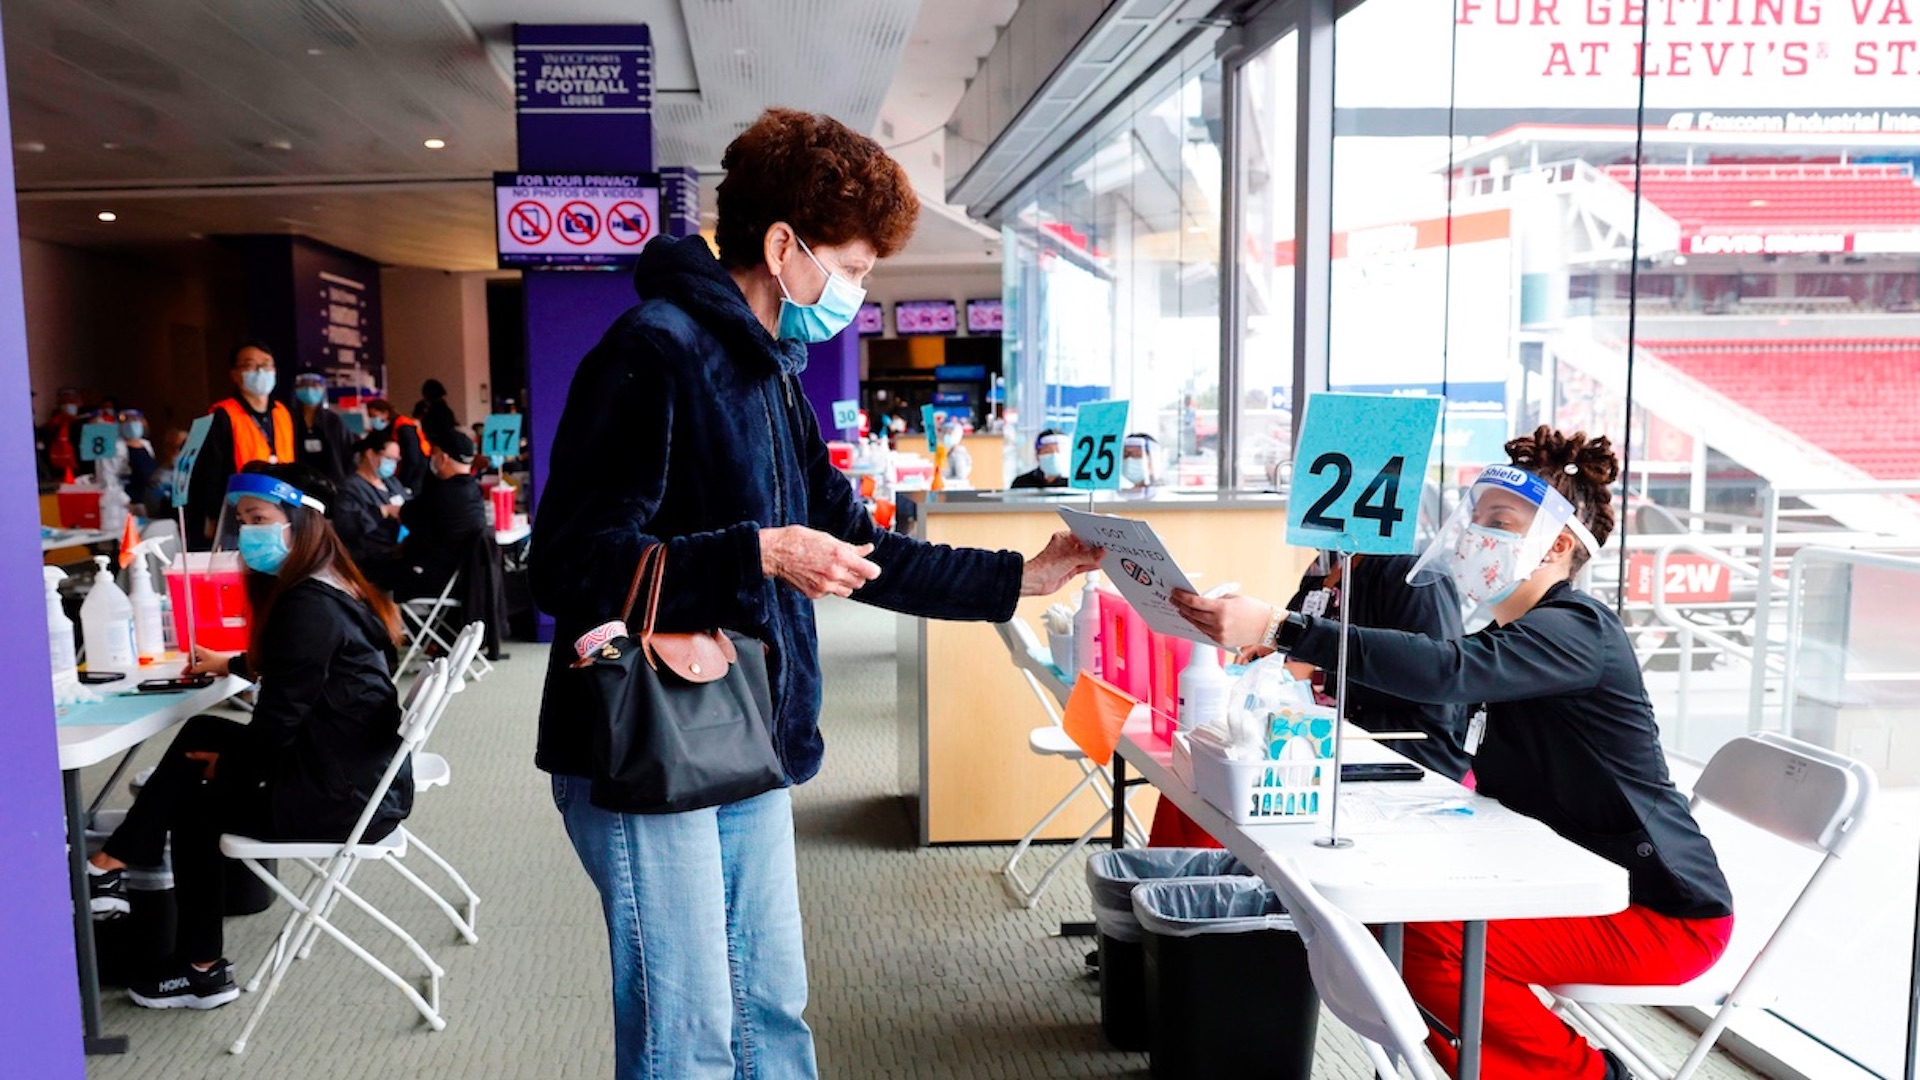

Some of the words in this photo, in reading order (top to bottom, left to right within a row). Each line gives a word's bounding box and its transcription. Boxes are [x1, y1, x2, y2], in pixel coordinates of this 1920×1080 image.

[1541, 42, 1609, 76] AT
[540, 64, 622, 79] FANTASY
[535, 79, 630, 94] FOOTBALL
[560, 94, 605, 106] LOUNGE
[516, 175, 544, 186] FOR
[546, 175, 582, 186] YOUR
[584, 175, 640, 187] PRIVACY
[512, 188, 530, 198] NO
[532, 188, 580, 198] PHOTOS
[582, 188, 600, 199] OR
[602, 188, 645, 199] VIDEOS
[837, 409, 856, 424] 30
[92, 436, 106, 456] 8
[486, 429, 516, 451] 17
[1075, 434, 1117, 481] 25
[1300, 451, 1405, 538] 24
[1101, 527, 1127, 540] GOT
[1664, 563, 1721, 594] 2W
[158, 976, 191, 993] HOKA
